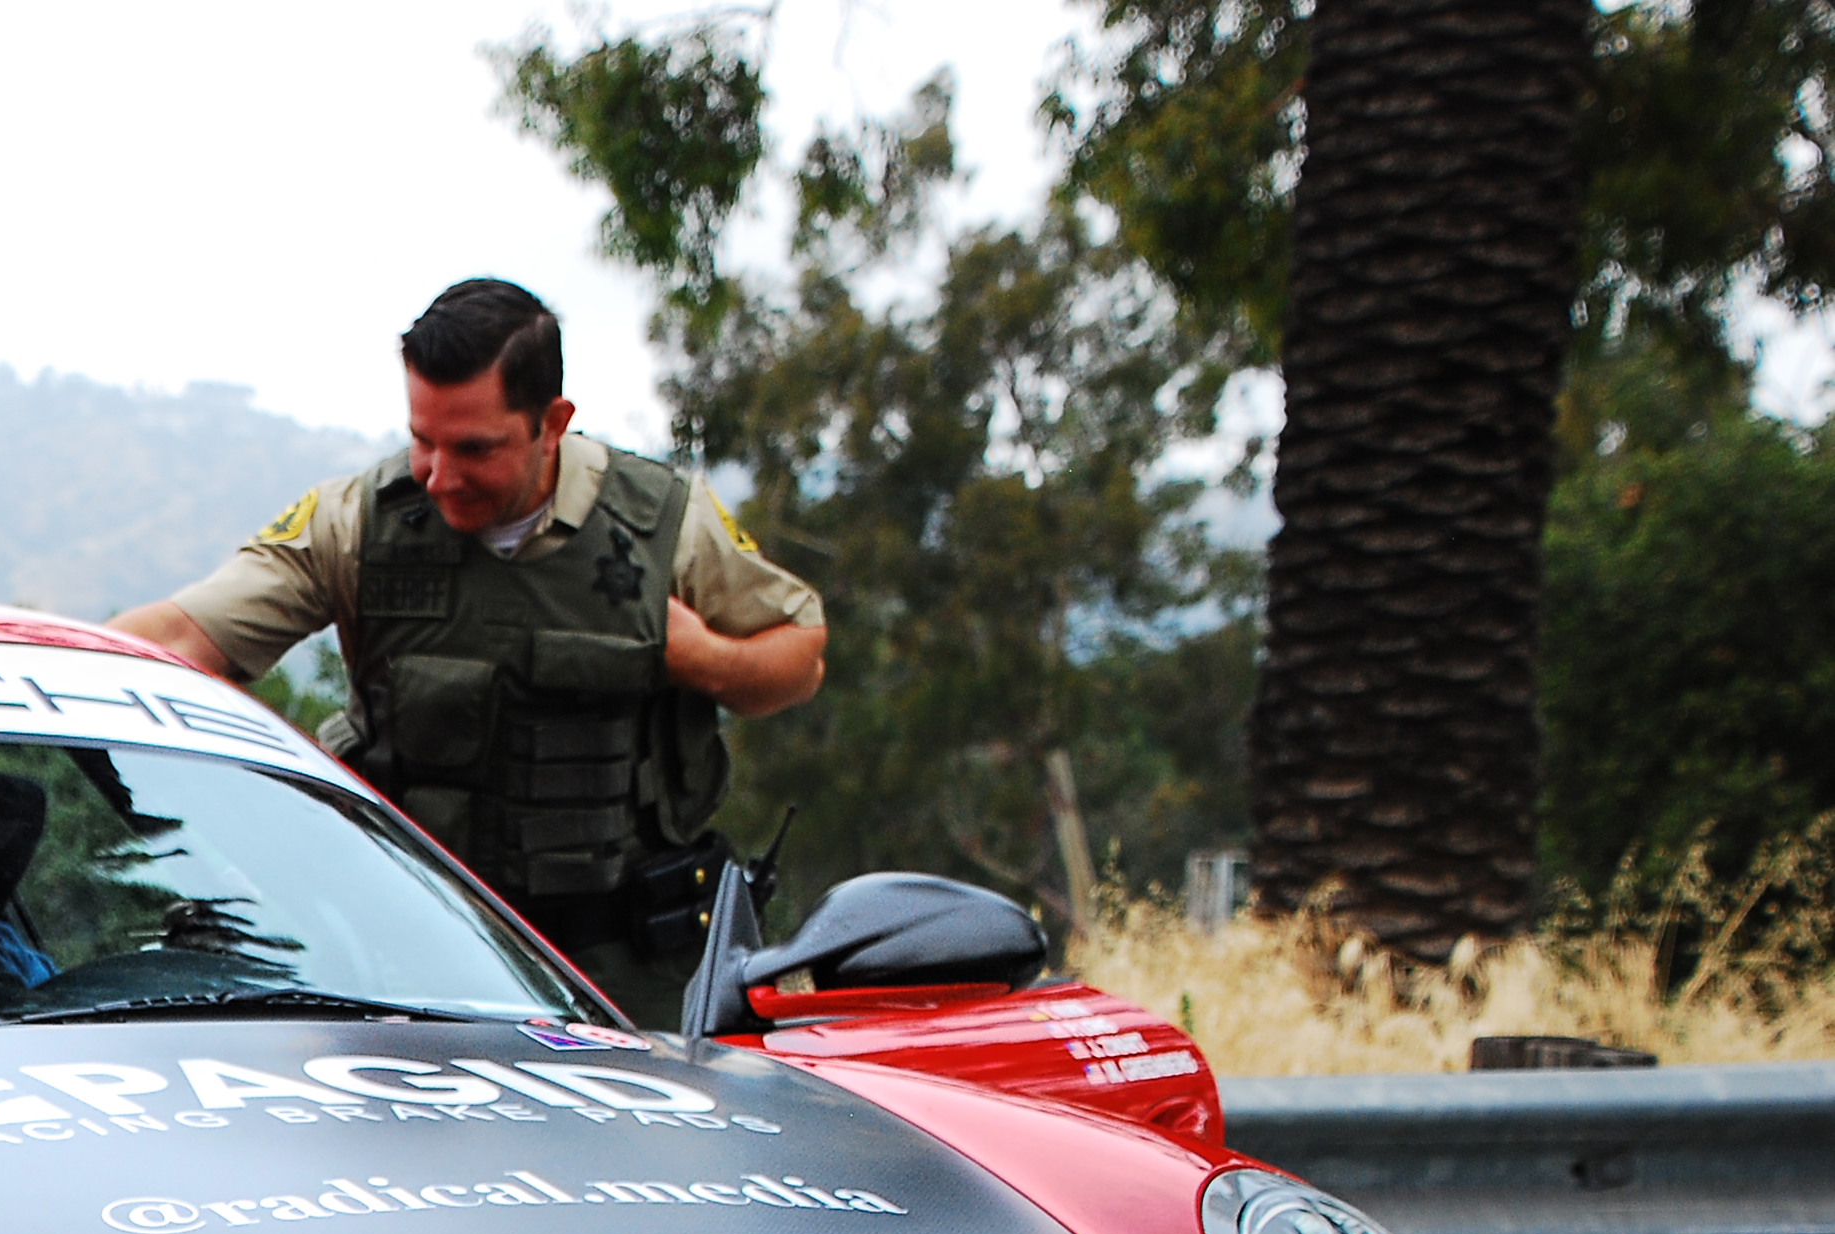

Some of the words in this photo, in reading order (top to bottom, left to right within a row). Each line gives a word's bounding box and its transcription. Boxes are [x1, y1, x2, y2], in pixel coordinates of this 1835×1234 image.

[19, 1055, 717, 1116] PAGID
[265, 1103, 548, 1125] BRAKE
[574, 1107, 782, 1134] PADS
[101, 1170, 909, 1234] @radical.media
